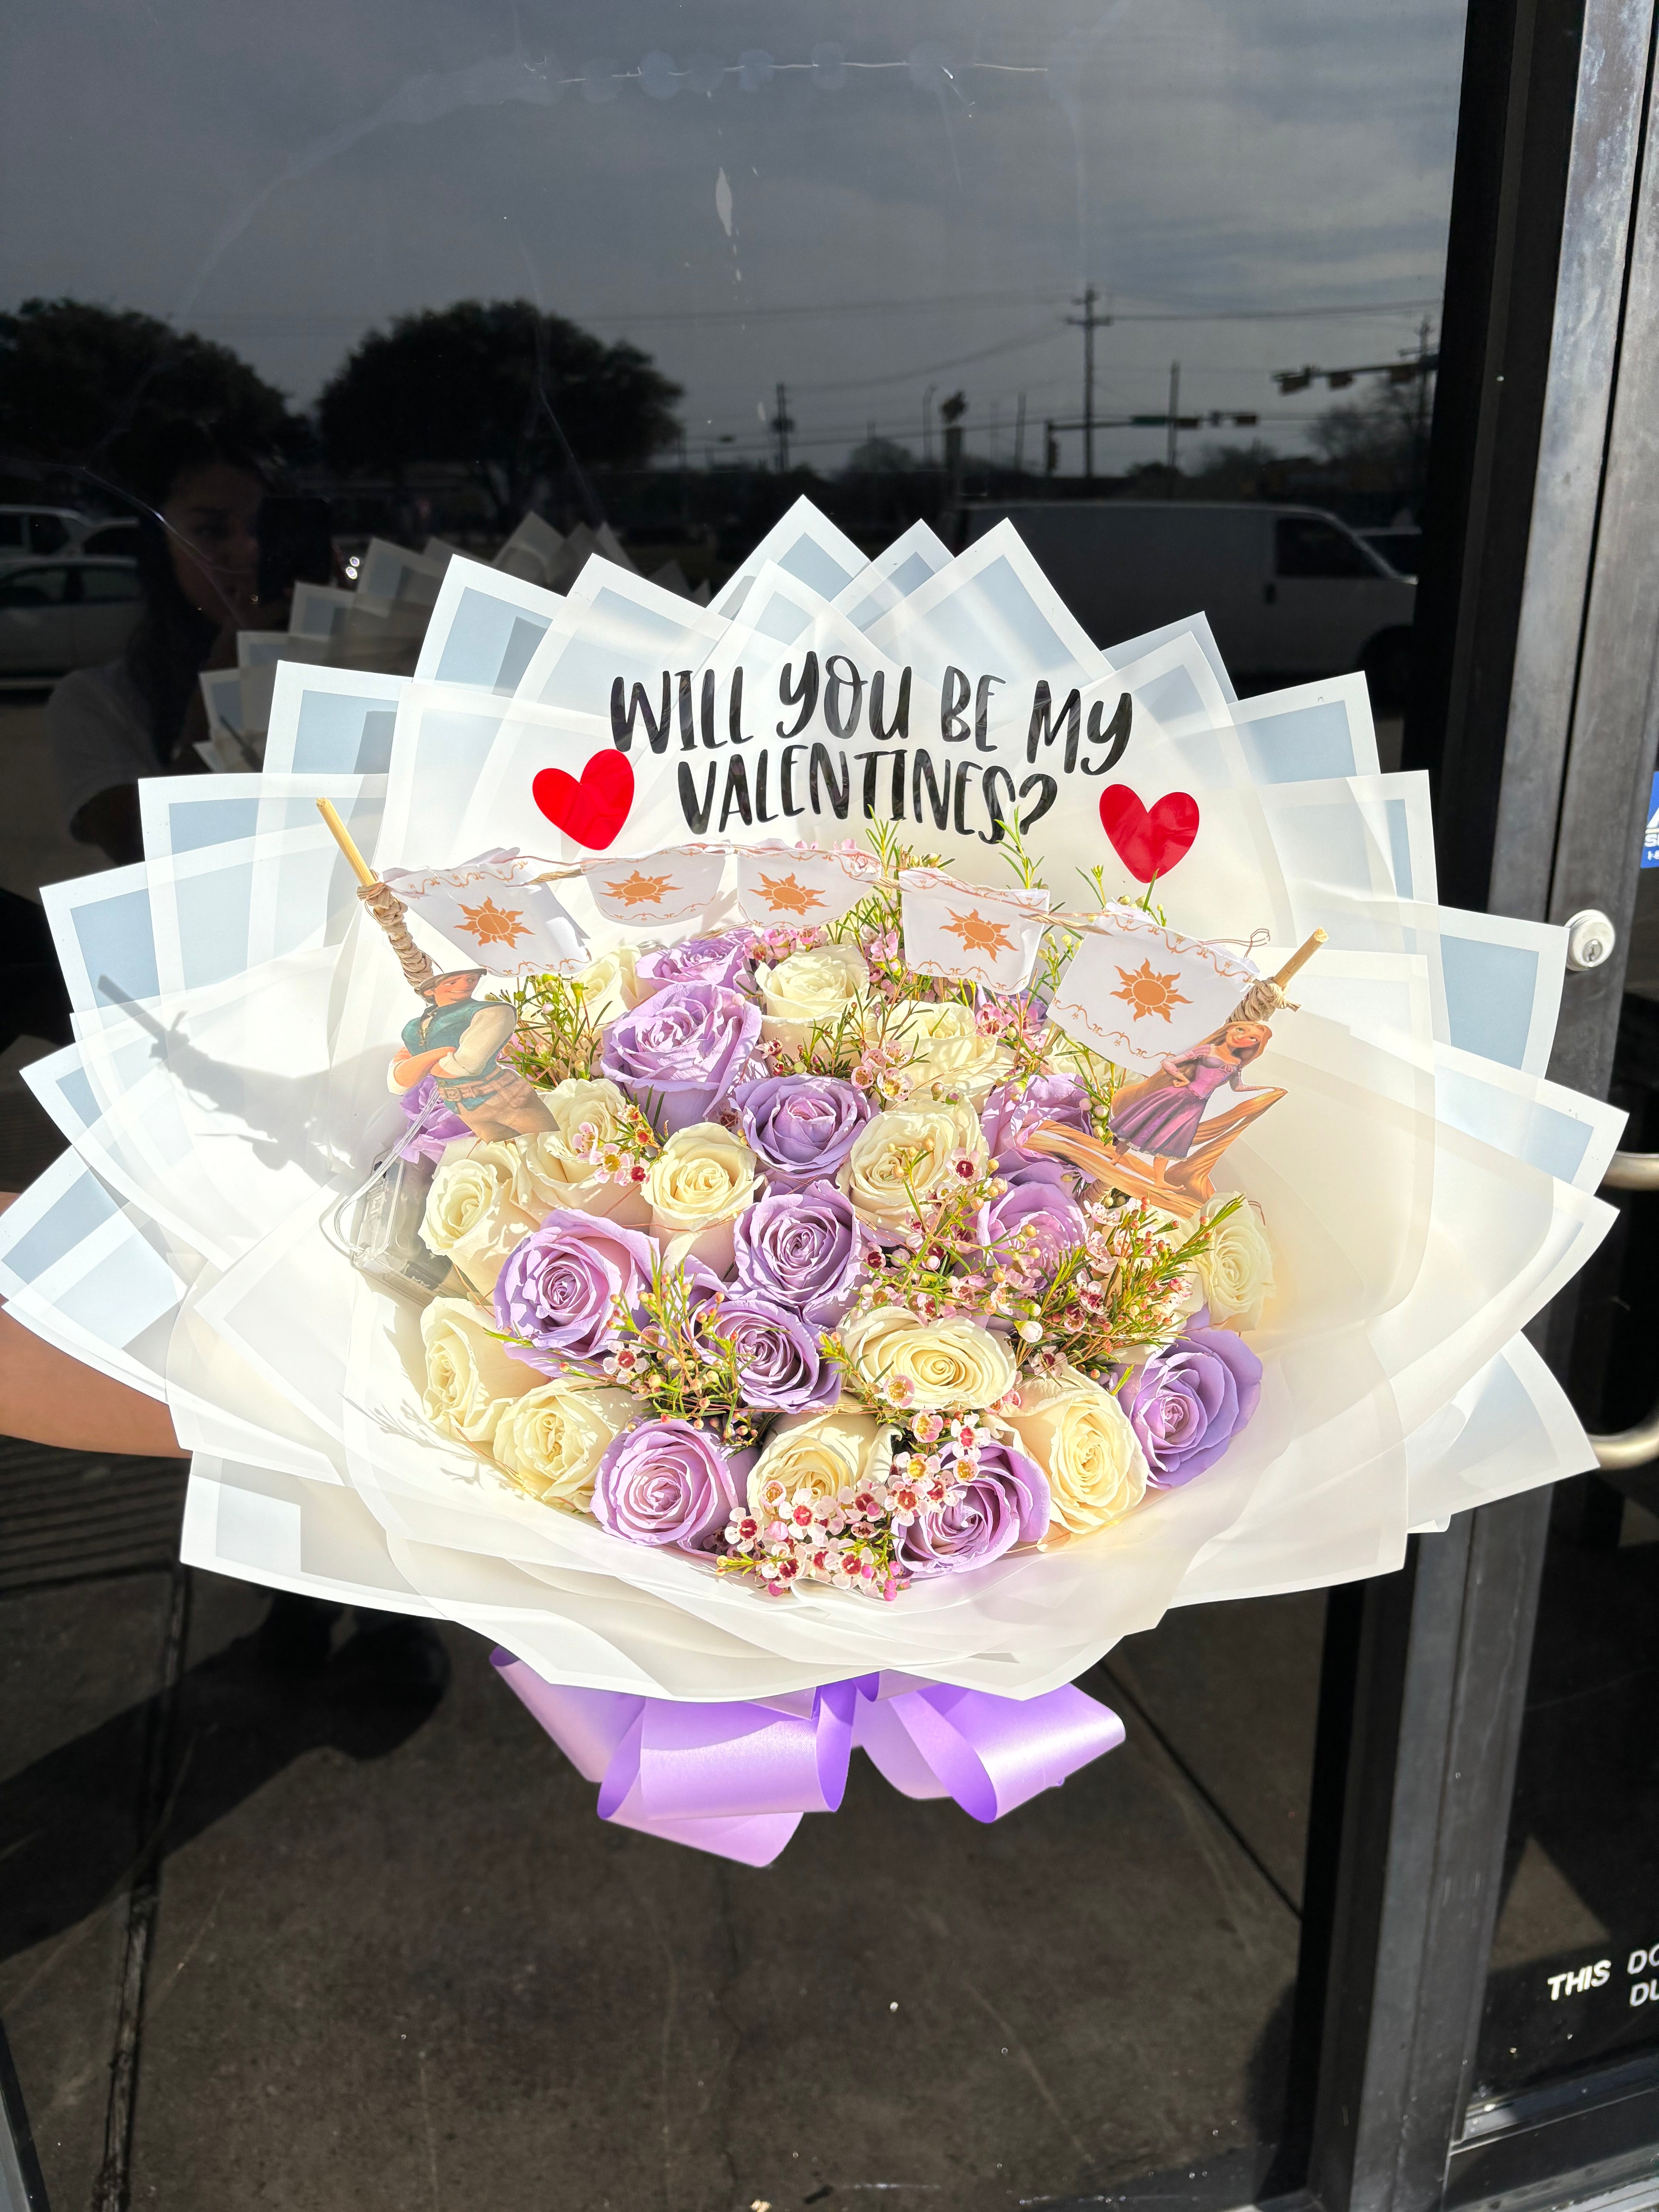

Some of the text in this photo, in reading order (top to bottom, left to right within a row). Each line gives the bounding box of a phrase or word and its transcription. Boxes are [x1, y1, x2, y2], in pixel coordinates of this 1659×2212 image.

[610, 666, 754, 754] WILL
[776, 651, 912, 740] YOU
[941, 665, 1006, 752] BE
[678, 742, 1058, 845] VALENTINES?
[1547, 1960, 1611, 2001] THIS
